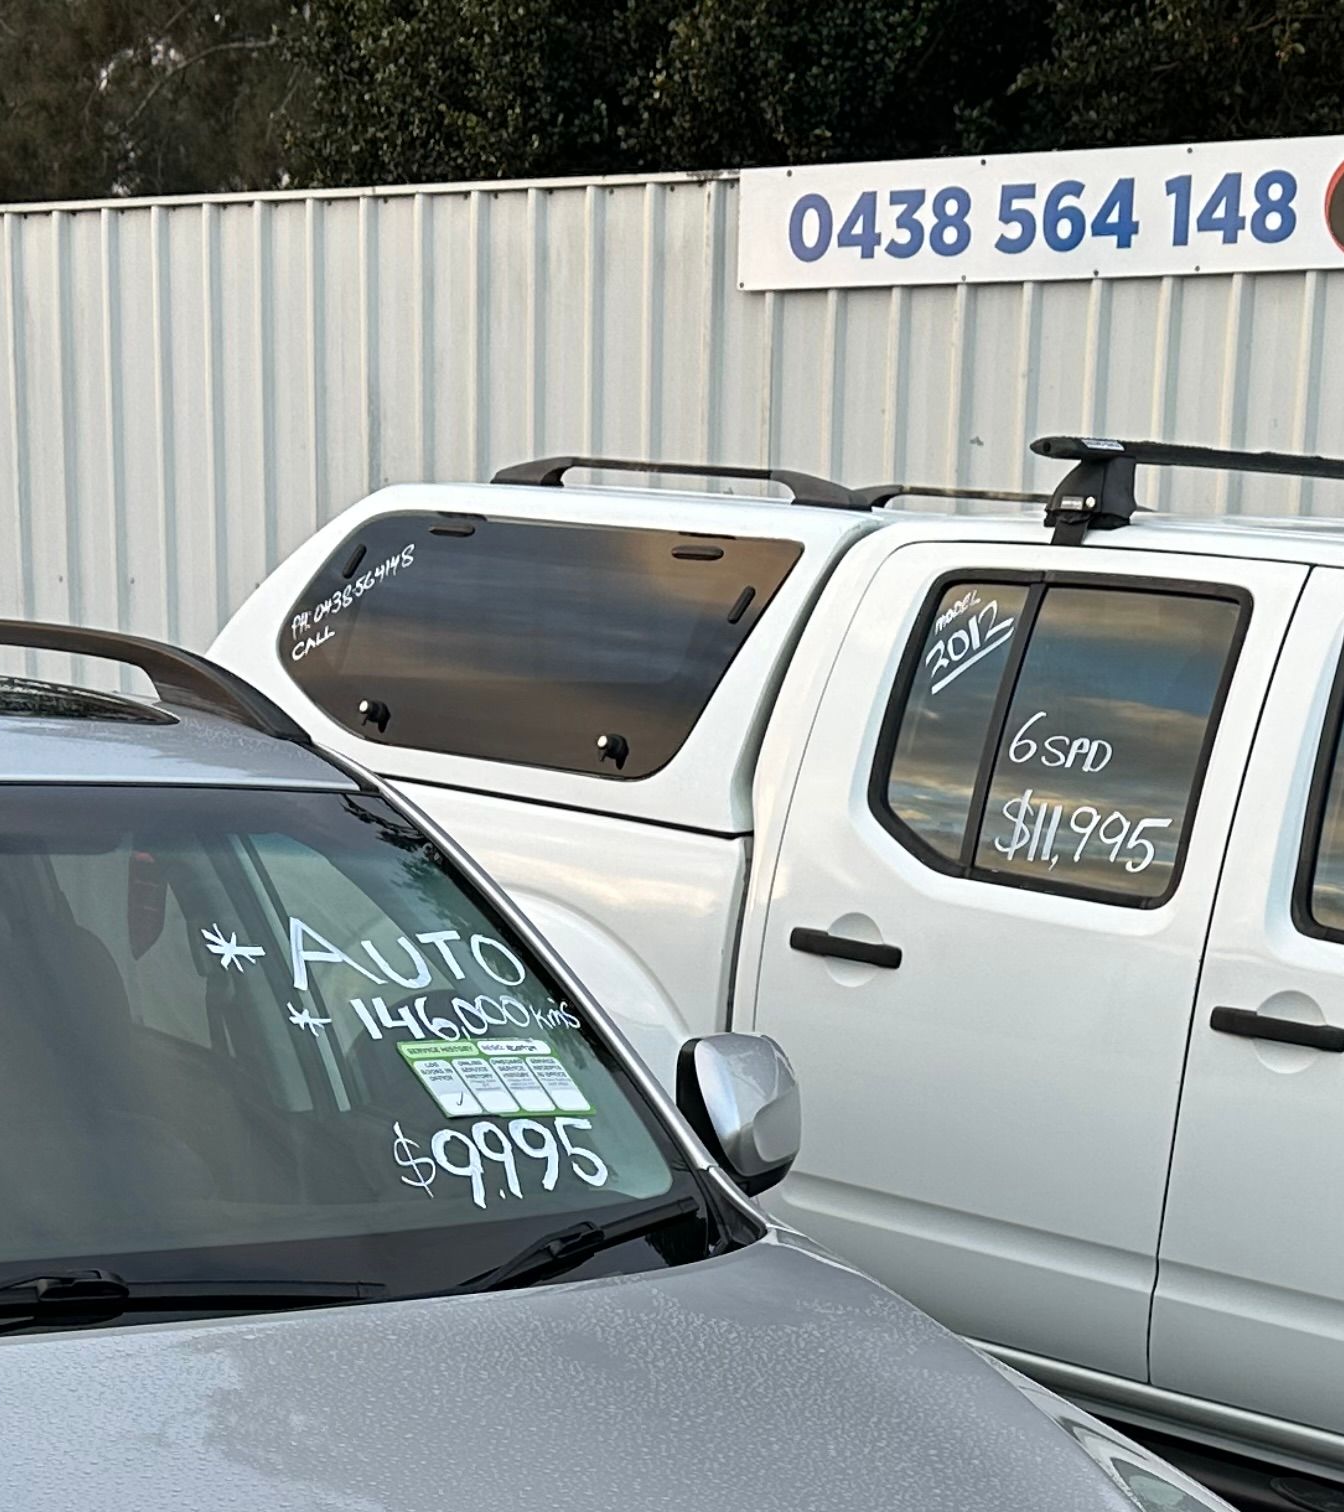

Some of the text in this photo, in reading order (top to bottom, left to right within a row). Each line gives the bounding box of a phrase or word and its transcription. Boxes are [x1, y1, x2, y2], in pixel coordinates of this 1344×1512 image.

[788, 169, 1299, 264] 0438 564 148
[291, 625, 336, 661] CALL
[925, 599, 1015, 679] 2012
[994, 788, 1174, 873] $11,995
[288, 915, 527, 991] AUTO
